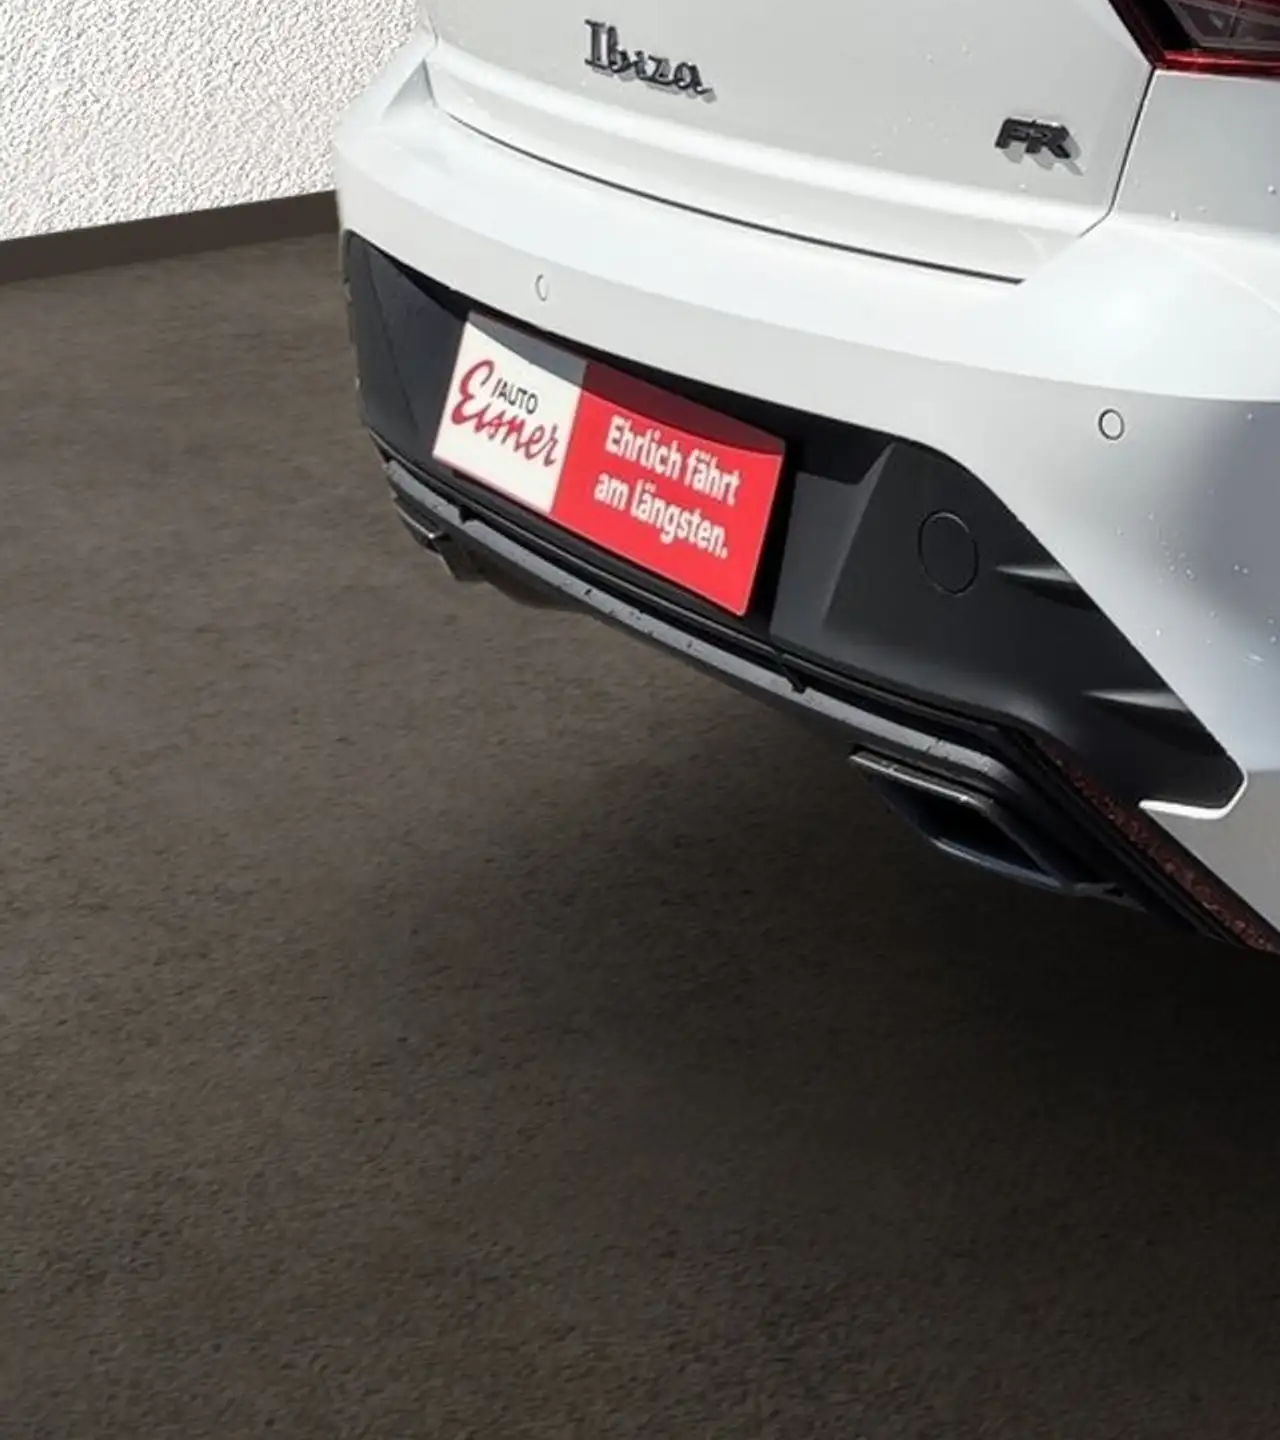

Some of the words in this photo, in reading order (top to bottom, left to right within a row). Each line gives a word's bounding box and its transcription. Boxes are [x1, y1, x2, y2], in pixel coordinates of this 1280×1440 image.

[584, 19, 714, 96] Ibiza
[995, 118, 1071, 159] FR
[450, 359, 559, 467] Eisner
[499, 379, 539, 416] AUTO
[605, 414, 683, 482] Ehrlich
[683, 447, 741, 506] fährt
[594, 472, 630, 511] am
[630, 478, 729, 560] längsten.
